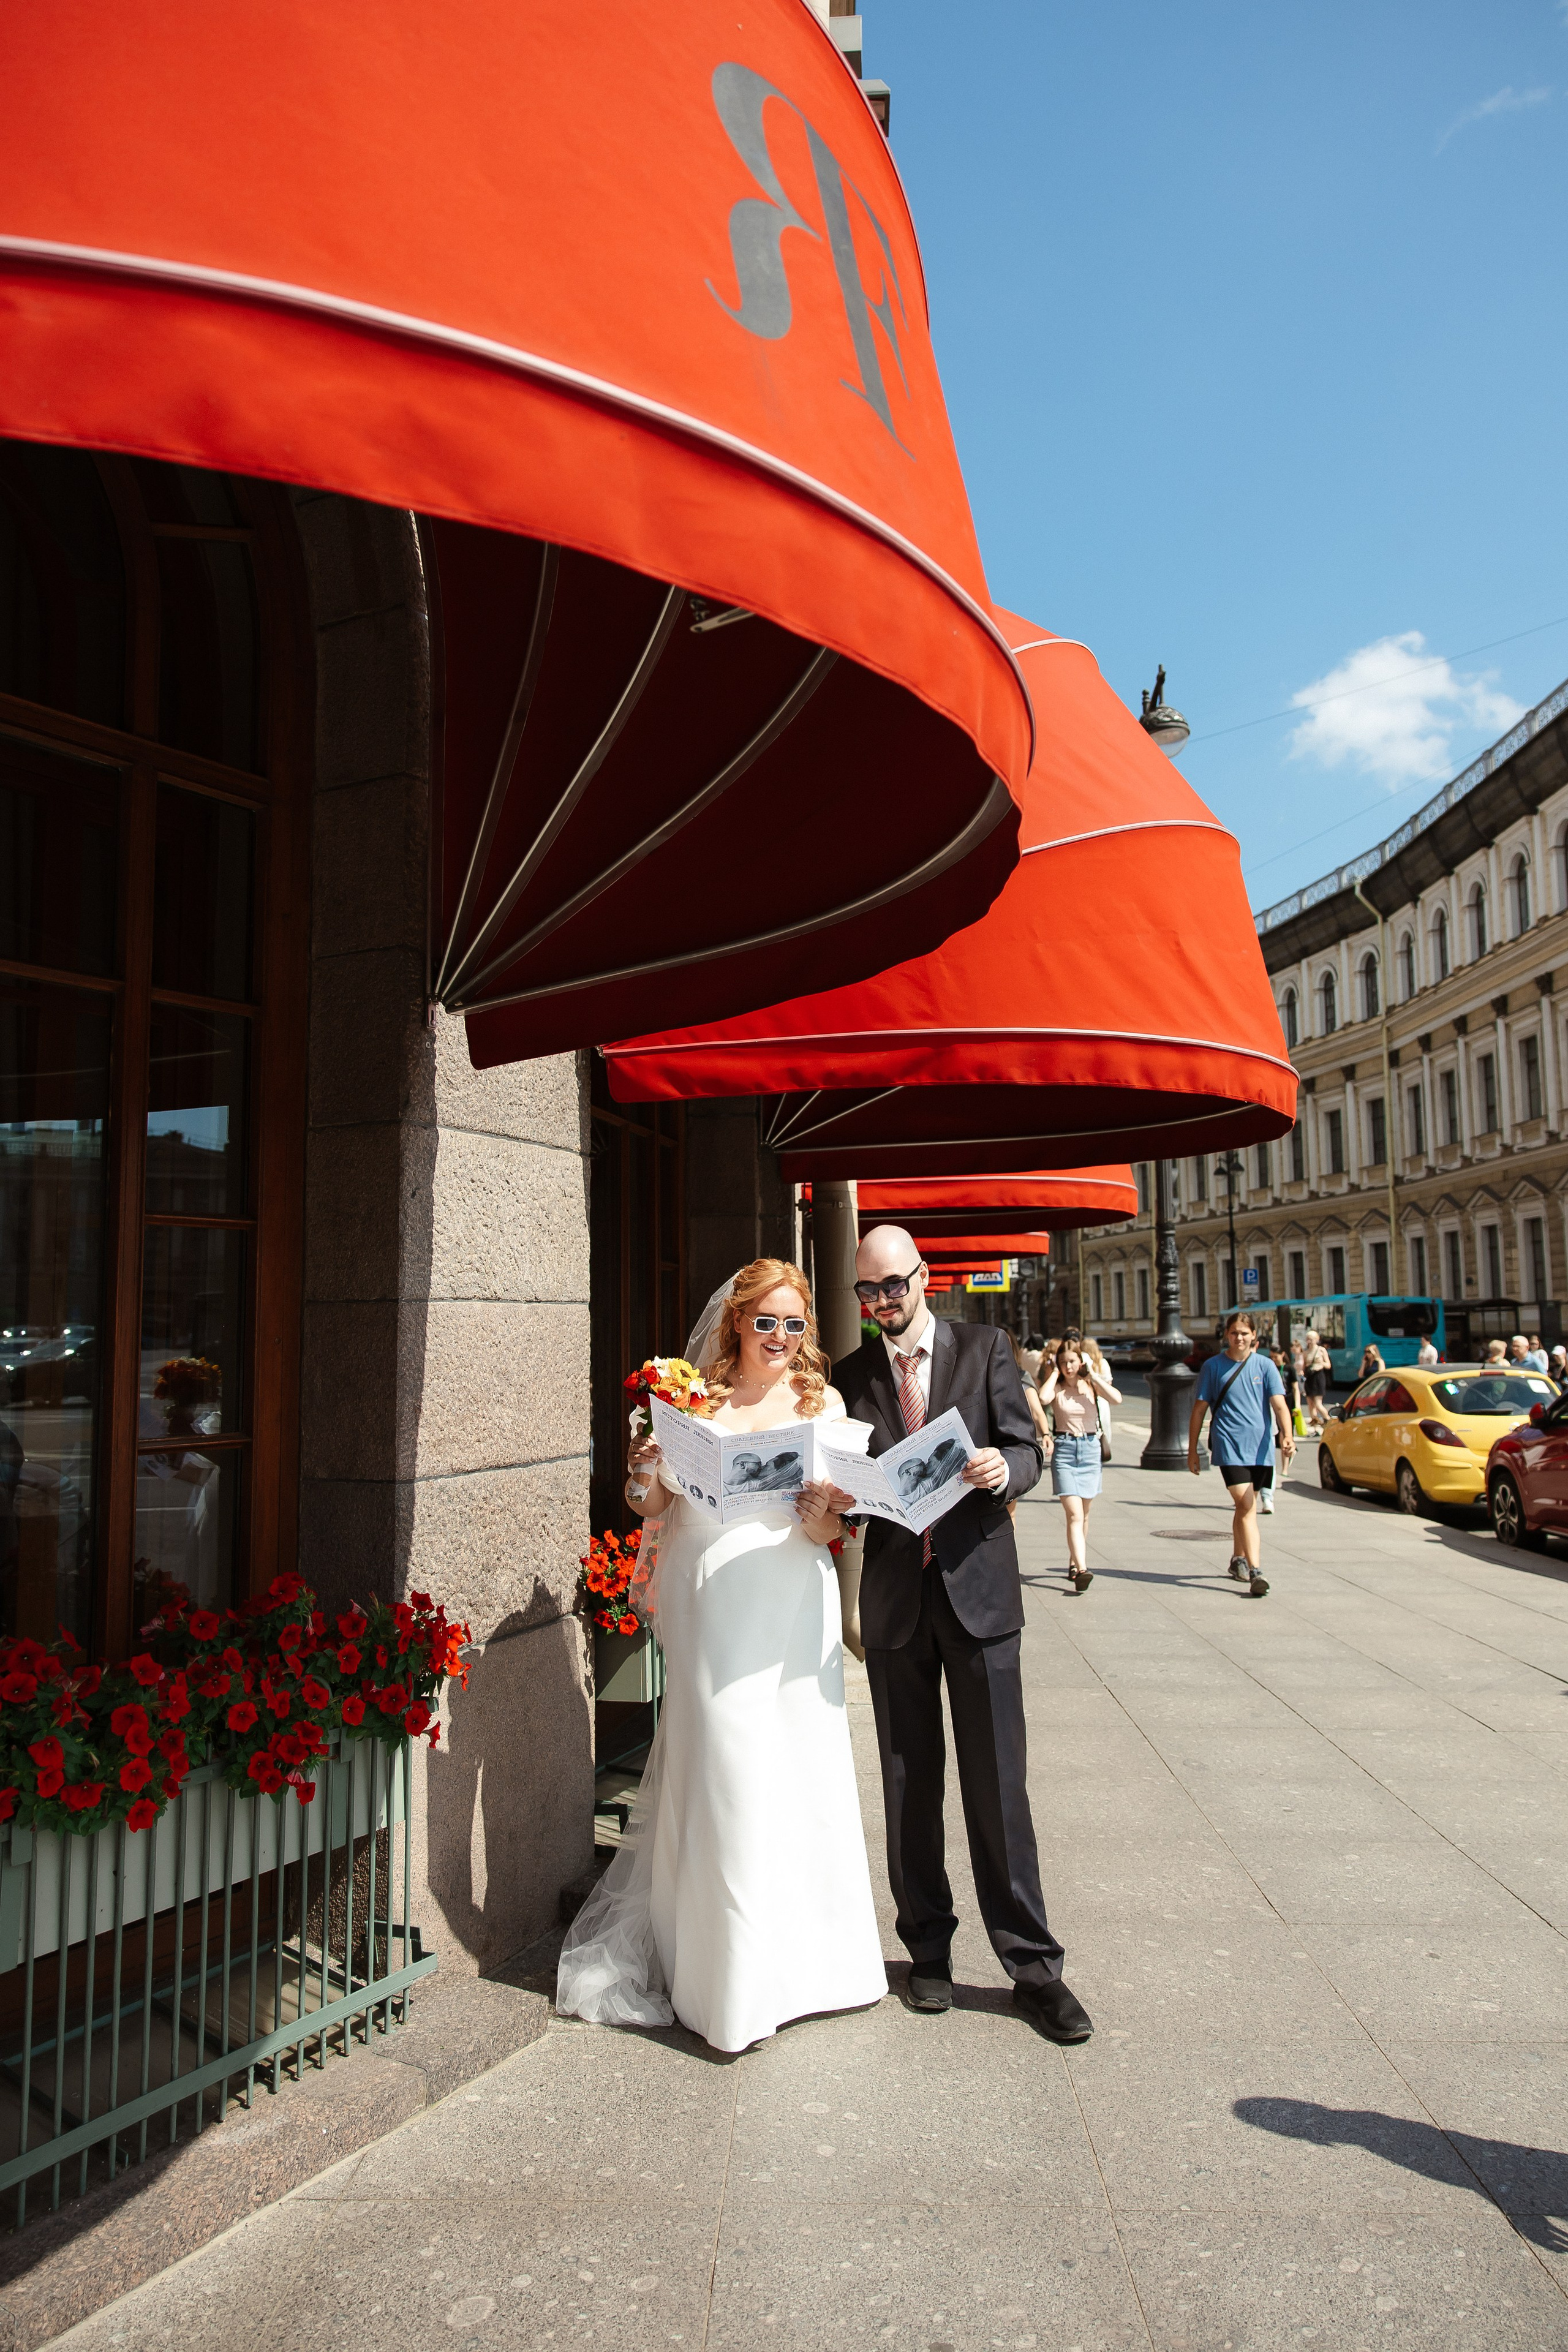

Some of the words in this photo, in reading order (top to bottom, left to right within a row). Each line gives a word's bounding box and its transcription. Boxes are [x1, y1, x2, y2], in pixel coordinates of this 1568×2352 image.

[662, 1410, 690, 1431] ИСТОРИЯ
[693, 1430, 714, 1446] ЛЮБВИ
[731, 1434, 766, 1442] СВАДЕБНЫЙ
[768, 1430, 794, 1439] ВЕСТНИК
[886, 1438, 916, 1459] СВАДЕБНЫЙ
[918, 1421, 942, 1438] ВЕСТНИК
